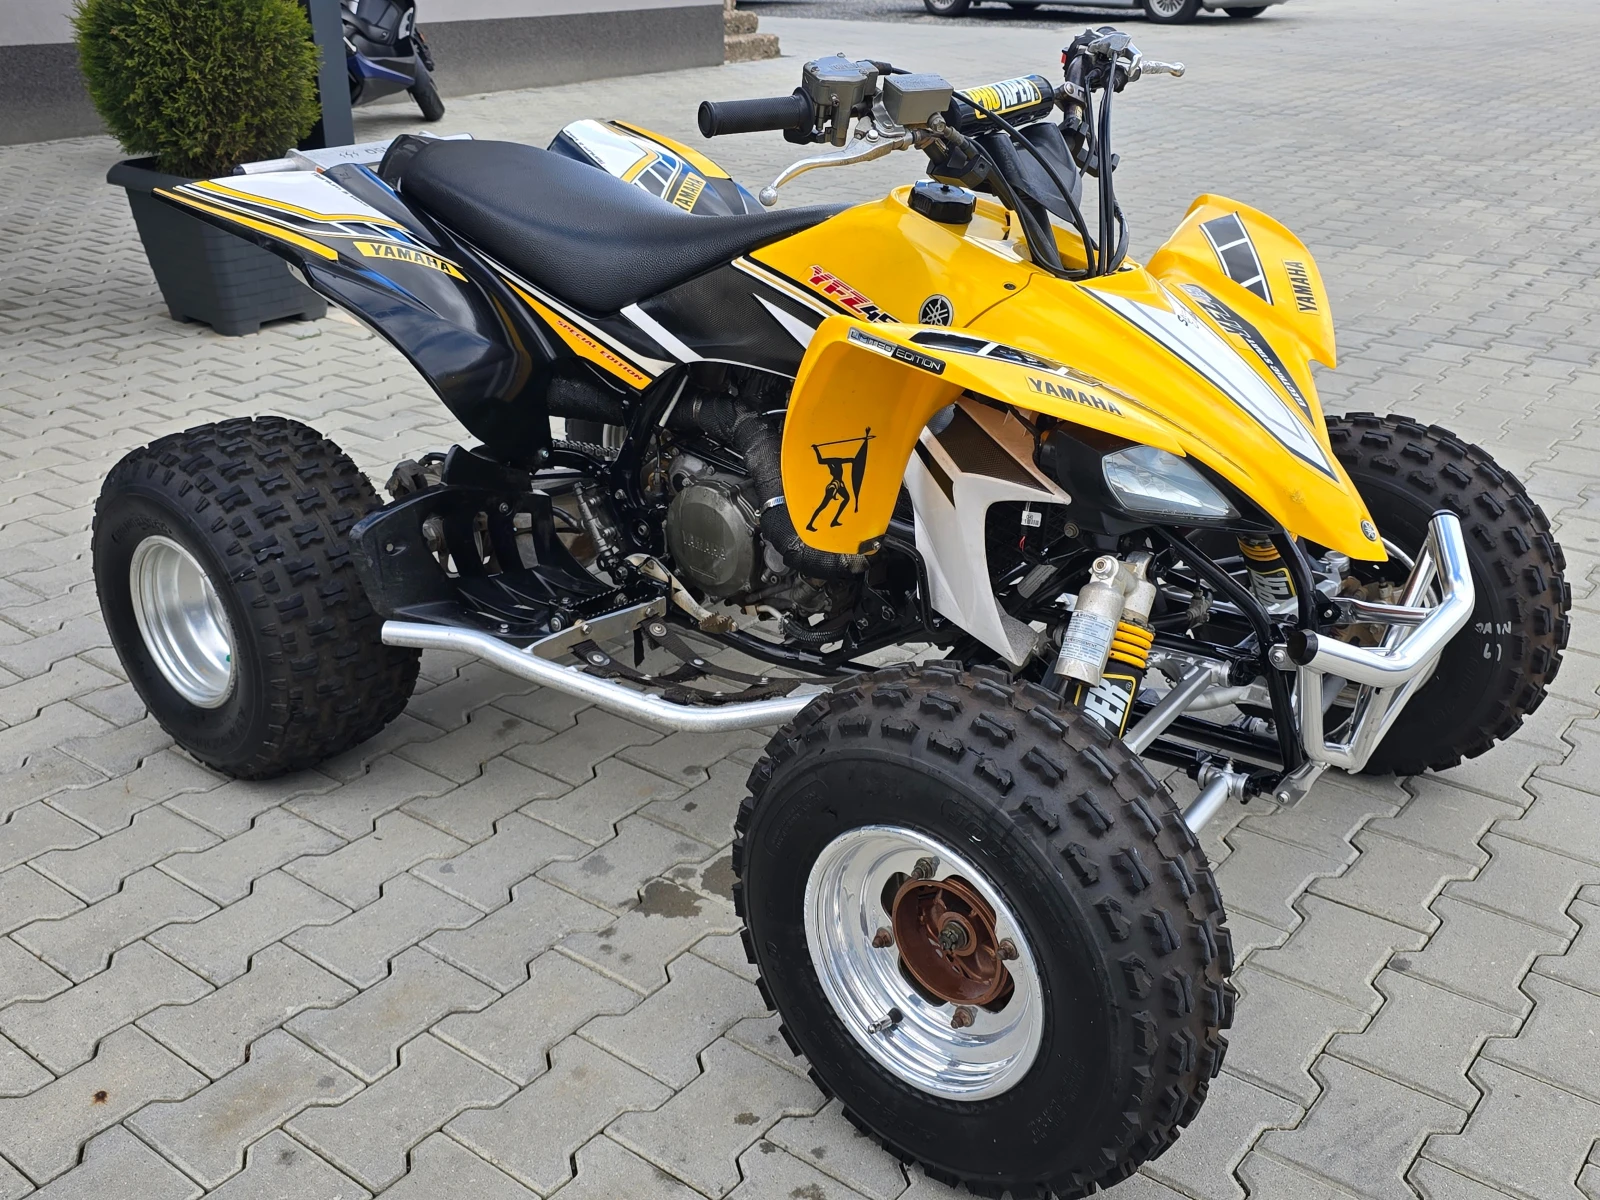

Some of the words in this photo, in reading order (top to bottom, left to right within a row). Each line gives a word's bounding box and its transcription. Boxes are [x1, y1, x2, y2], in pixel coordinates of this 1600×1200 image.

[370, 243, 452, 274] YAMAHA
[1284, 261, 1318, 311] YAMAHA
[557, 320, 598, 351] SPECIAL
[600, 350, 643, 381] EDITION
[850, 329, 893, 353] LIMITED
[895, 348, 942, 371] EDITION
[1248, 339, 1274, 365] START
[1028, 377, 1122, 416] YAMAHA
[1270, 364, 1308, 408] ELECTRIC
